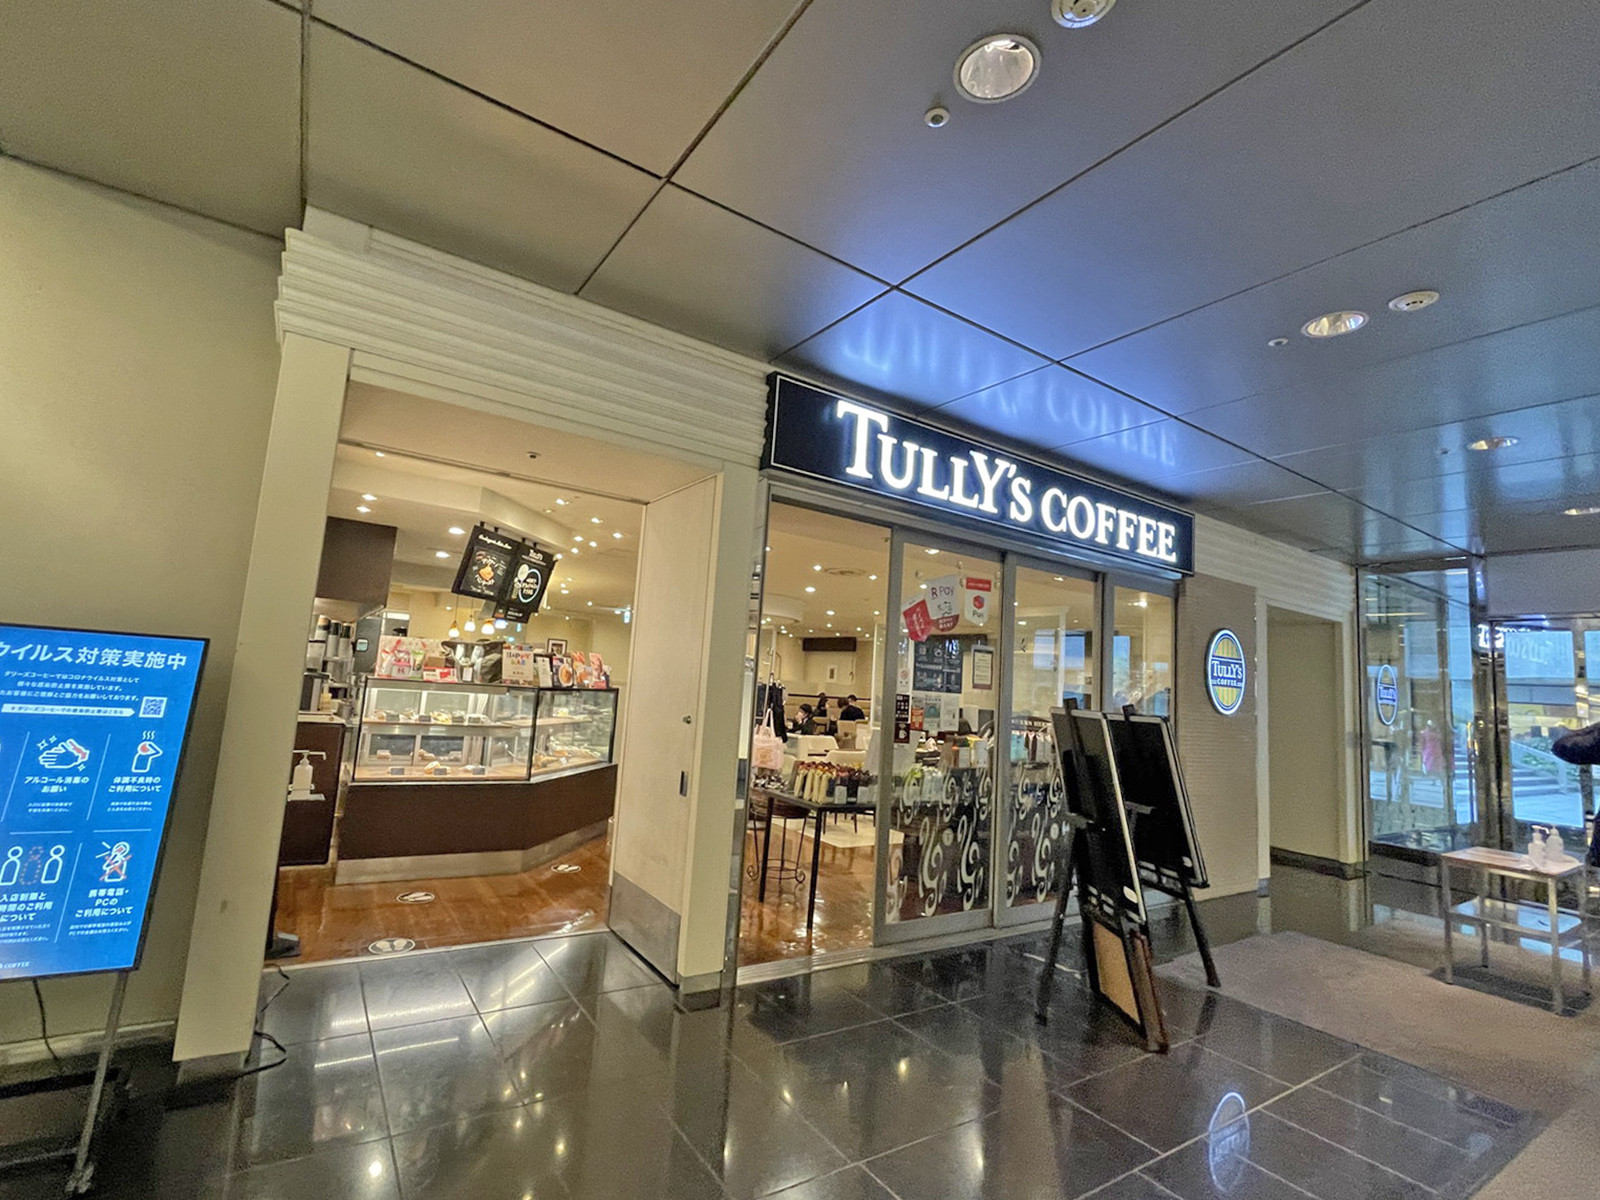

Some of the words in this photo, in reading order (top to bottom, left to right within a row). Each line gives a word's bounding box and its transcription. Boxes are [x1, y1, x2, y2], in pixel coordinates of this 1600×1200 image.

[837, 400, 1032, 522] TULLY'S
[1041, 487, 1177, 562] COFFEE
[1211, 661, 1243, 679] TULLY'S
[24, 776, 90, 785] アルコール消毒の
[94, 898, 119, 907] PCの
[75, 906, 134, 918] ご利用について
